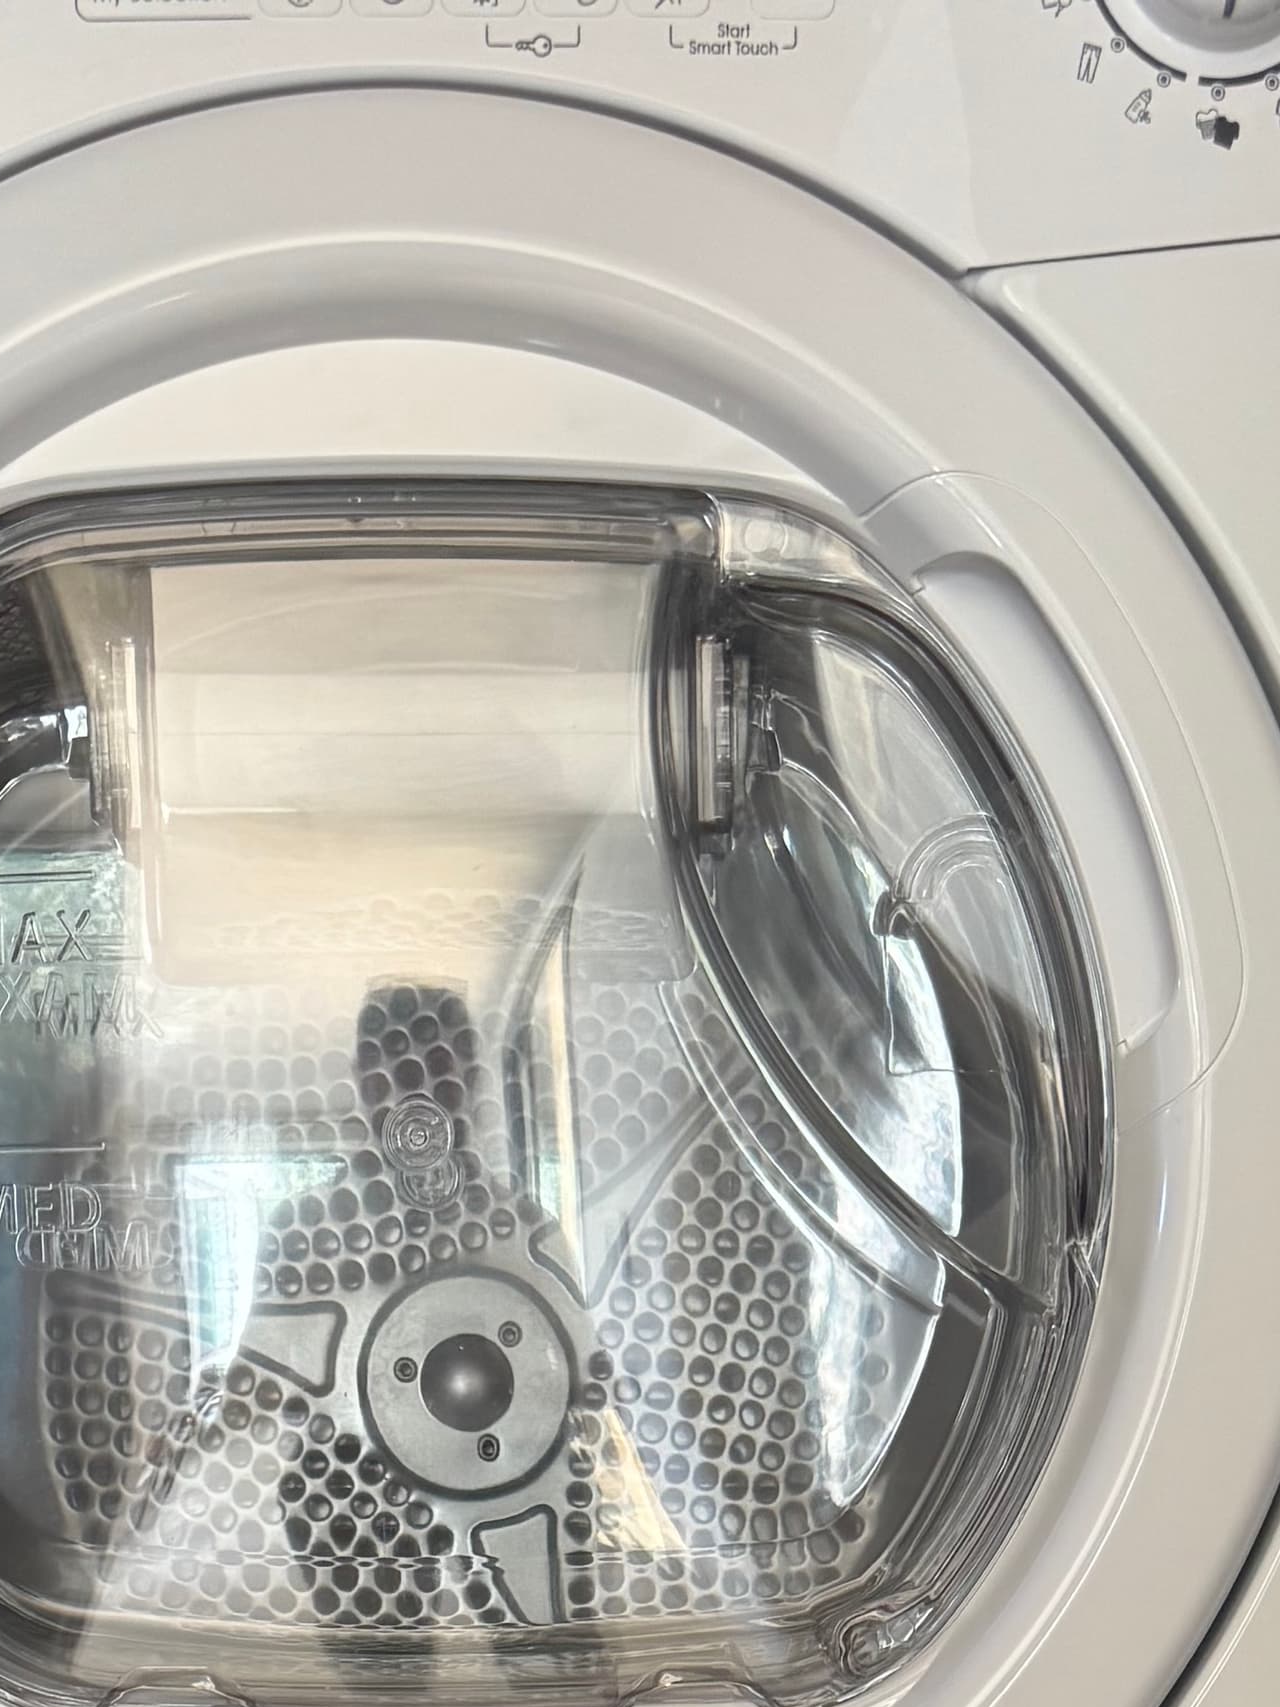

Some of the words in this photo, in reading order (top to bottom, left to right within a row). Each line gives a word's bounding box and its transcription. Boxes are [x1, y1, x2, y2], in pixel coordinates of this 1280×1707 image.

[717, 23, 750, 39] Start
[688, 40, 732, 56] Smart
[735, 40, 779, 56] Touch
